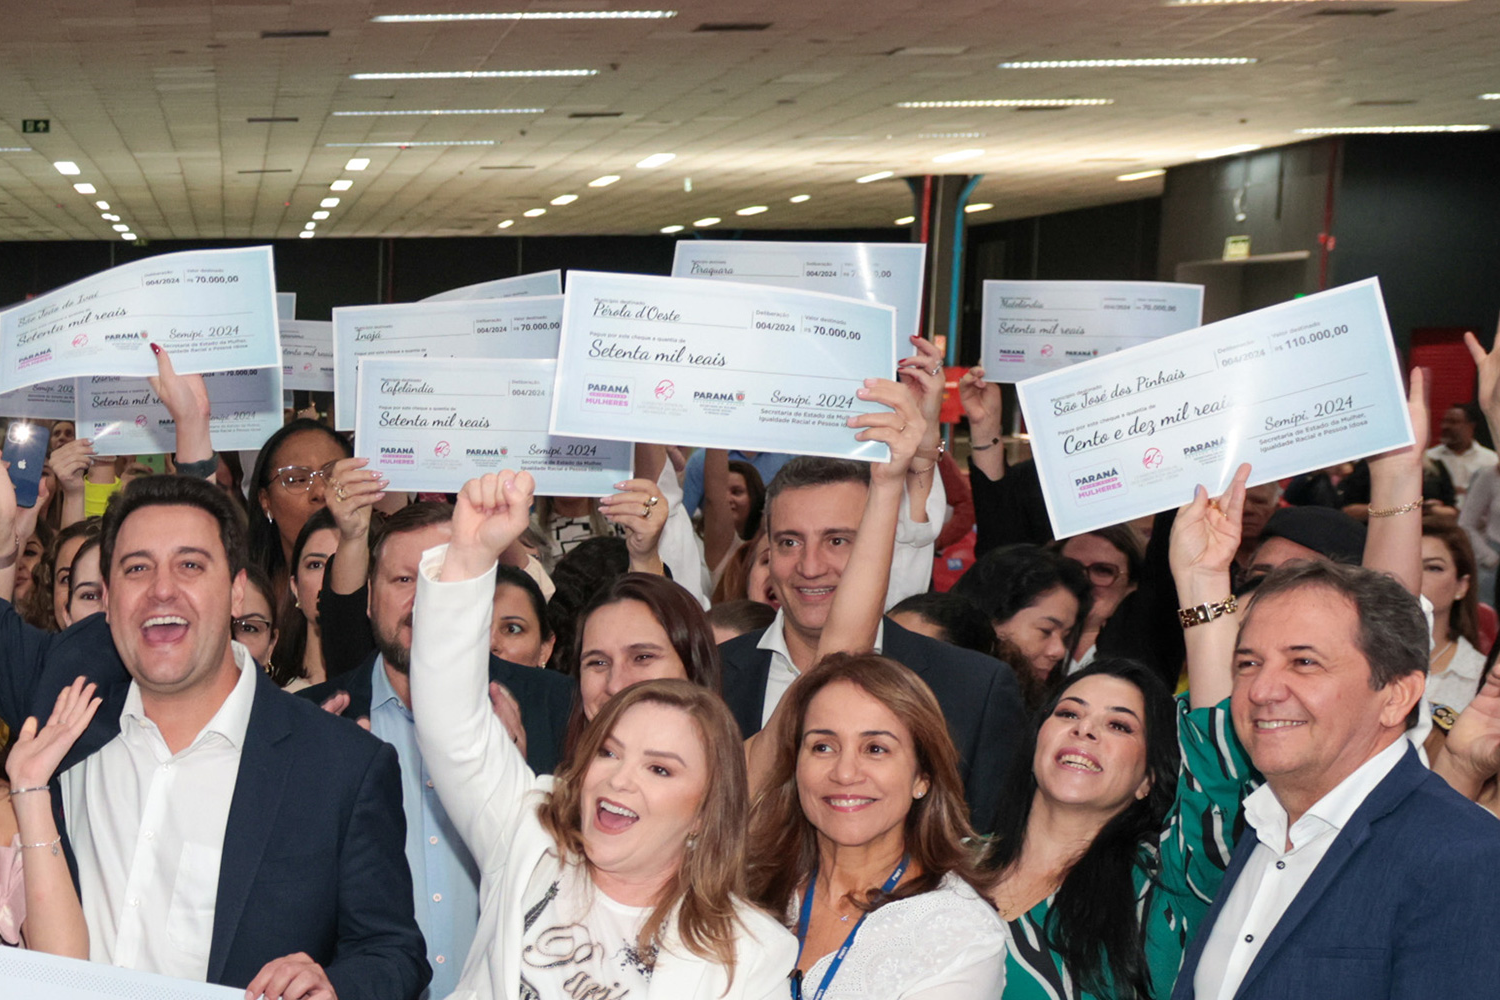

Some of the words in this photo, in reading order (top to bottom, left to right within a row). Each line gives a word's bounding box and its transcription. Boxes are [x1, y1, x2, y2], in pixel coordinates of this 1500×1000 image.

[146, 278, 180, 286] 004/2024
[195, 276, 239, 284] 70.000,00
[593, 301, 636, 319] Pérola
[17, 324, 64, 347] Setenta
[68, 311, 92, 329] mil
[95, 307, 127, 320] reais
[208, 325, 240, 337] 2024
[476, 325, 507, 334] 004/2024
[520, 321, 560, 331] 70.000,00
[756, 321, 796, 333] 004/2024
[813, 325, 861, 342] 70.000,00
[355, 329, 382, 341] Inajá
[1285, 324, 1349, 349] 110.000,00
[588, 339, 652, 362] Setenta
[655, 346, 686, 364] mil
[688, 350, 728, 368] reais
[1222, 349, 1265, 367] 004/2024
[380, 381, 435, 395] Cafelândia
[512, 388, 545, 397] 004/2024
[1053, 400, 1077, 417] São
[1081, 390, 1107, 409] José
[1110, 384, 1132, 399] dos
[1136, 369, 1186, 392] Pinhais
[817, 393, 854, 409] 2024
[1314, 395, 1353, 418] 2024
[378, 411, 430, 428] Setenta
[432, 412, 457, 427] mil
[459, 415, 490, 428] reais
[1063, 430, 1109, 454] Cento
[1114, 430, 1124, 440] e
[1128, 416, 1156, 436] dez
[1160, 402, 1190, 427] mil
[566, 445, 597, 457] 2024
